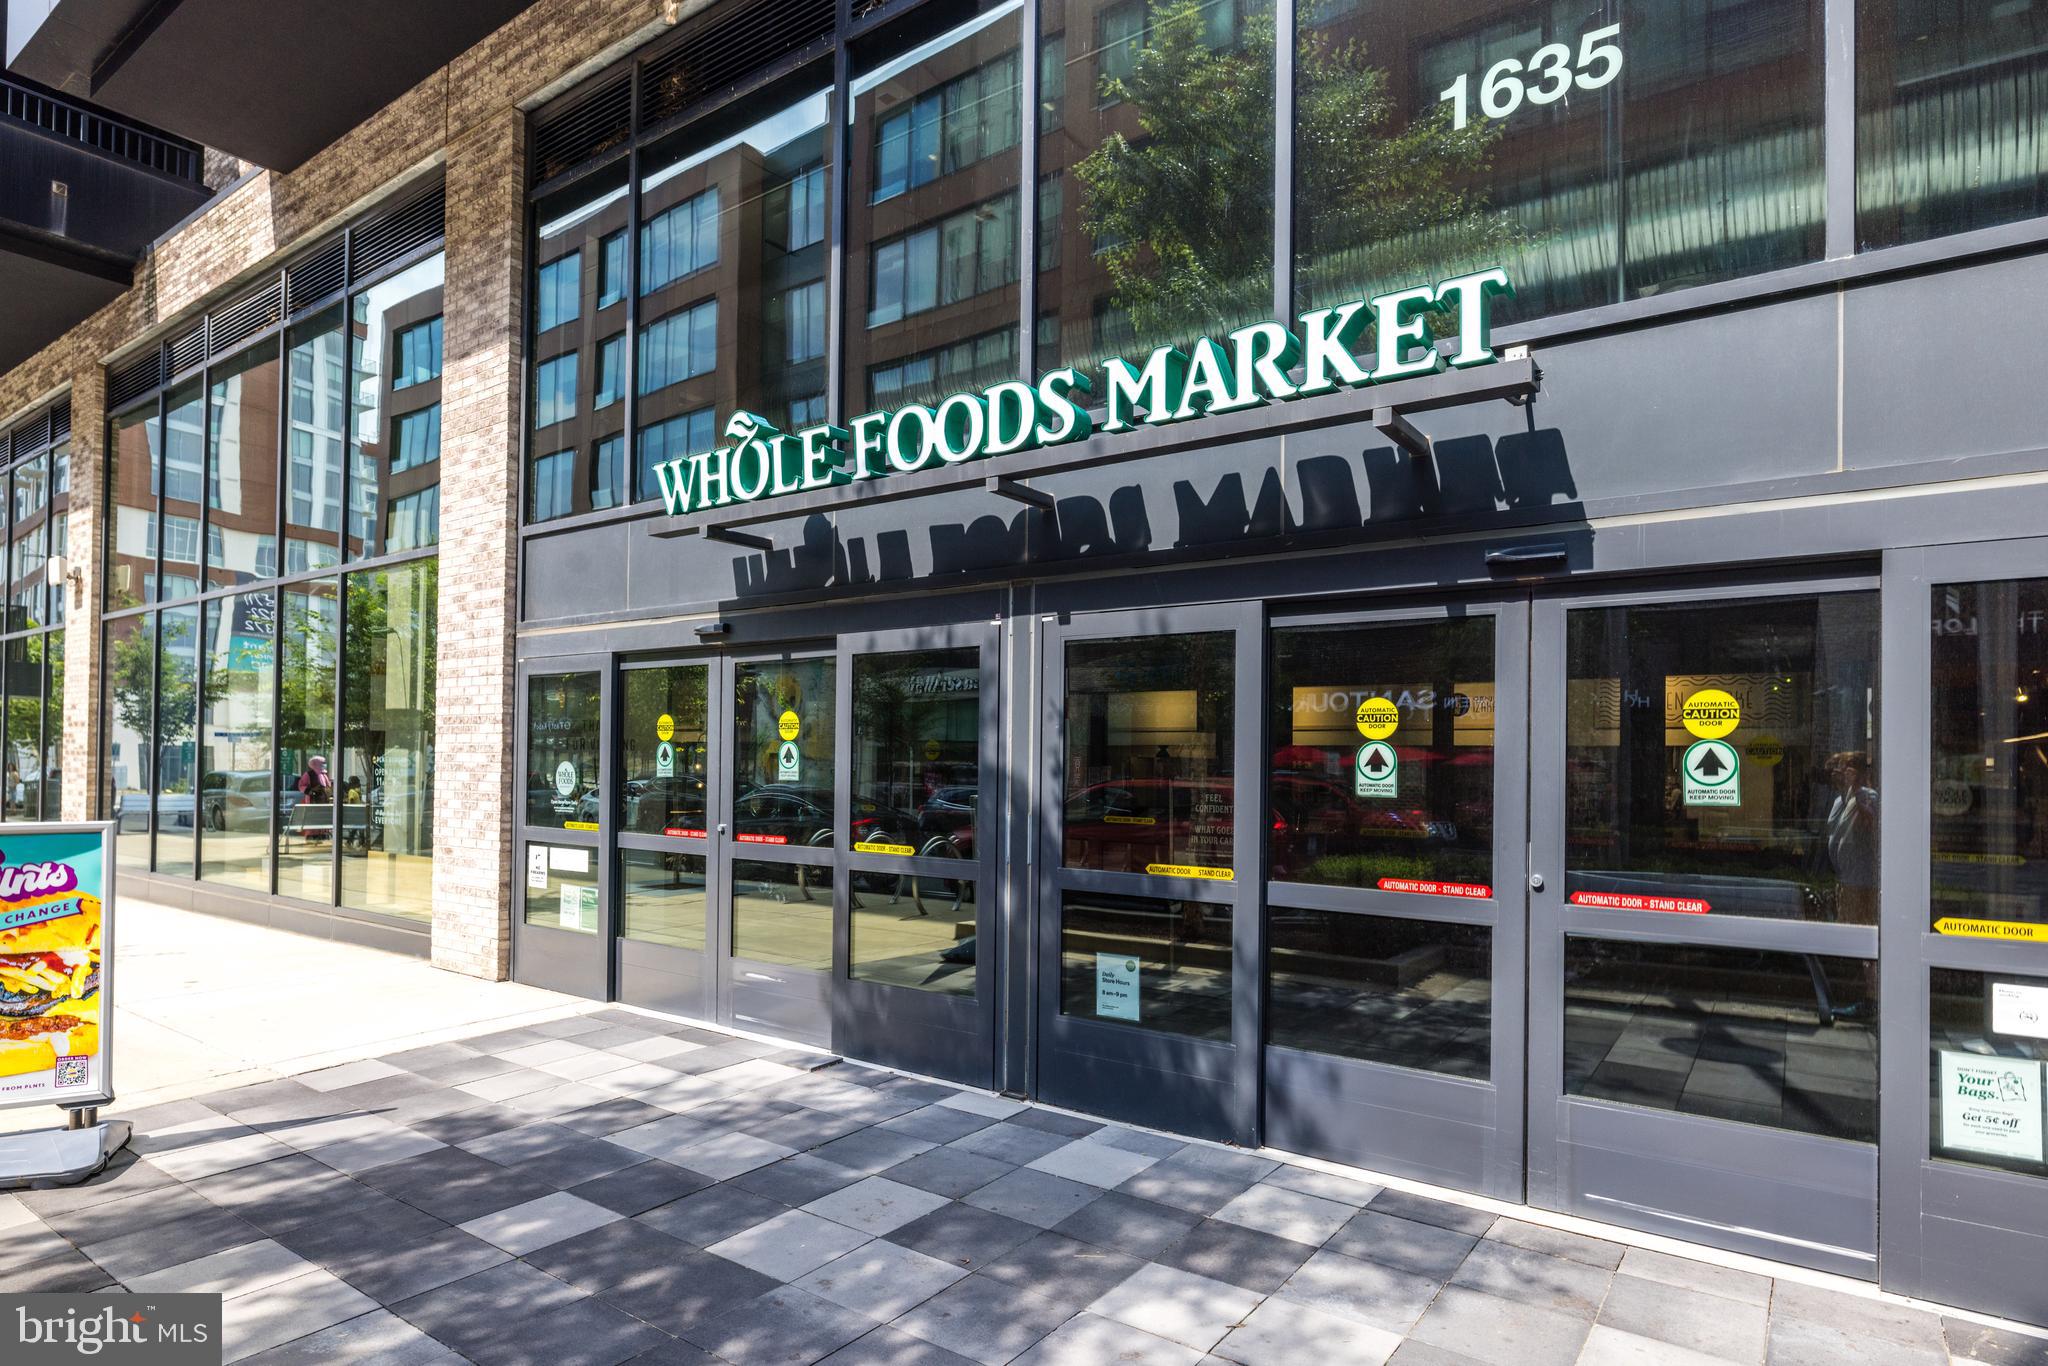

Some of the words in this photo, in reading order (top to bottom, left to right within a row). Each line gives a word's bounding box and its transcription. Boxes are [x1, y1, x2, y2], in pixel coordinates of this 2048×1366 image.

[1440, 22, 1623, 131] 1635
[851, 368, 1083, 480] FOODS
[1101, 266, 1513, 433] MARKET
[1357, 714, 1398, 723] CAUTION
[1683, 709, 1740, 719] CAUTION
[1205, 793, 1223, 803] FEEL
[1195, 804, 1234, 814] CONFIDENT
[1194, 825, 1216, 834] WHAT
[0, 862, 69, 895] lnts
[1177, 867, 1191, 875] DOOR
[1215, 870, 1231, 878] CLEAR
[1384, 881, 1418, 891] AUTOMATIC
[1420, 883, 1437, 892] DOOR
[1442, 886, 1464, 895] STAND
[1465, 887, 1486, 896] CLEAR
[1578, 894, 1620, 905] AUTOMATIC
[1621, 897, 1642, 908] DOOR
[1649, 899, 1675, 910] STAND
[1677, 901, 1702, 912] CLEAR
[5, 902, 71, 924] CHANGE
[1943, 922, 2001, 934] AUTOMATIC
[2003, 927, 2034, 937] DOOR
[1115, 978, 1130, 986] Hours
[1957, 1073, 1994, 1086] Your
[1957, 1085, 1999, 1100] Bags.
[1962, 1112, 1982, 1122] Get
[1985, 1115, 2000, 1125] 5¢
[2002, 1117, 2021, 1128] off
